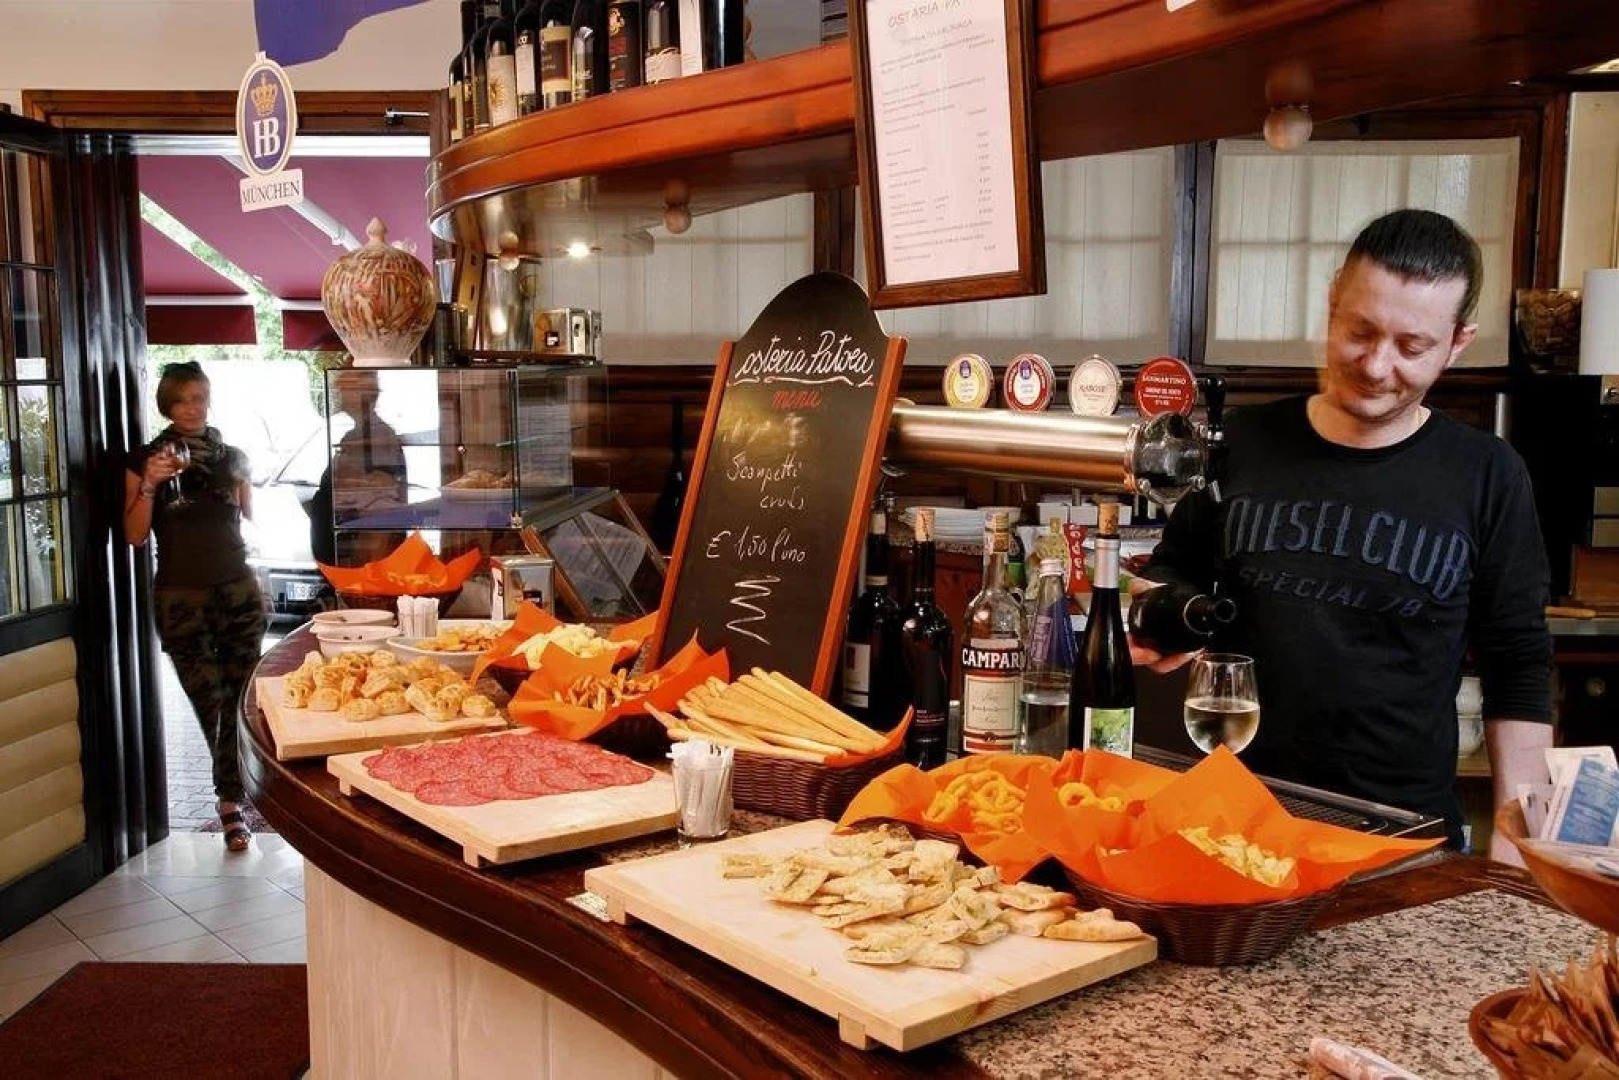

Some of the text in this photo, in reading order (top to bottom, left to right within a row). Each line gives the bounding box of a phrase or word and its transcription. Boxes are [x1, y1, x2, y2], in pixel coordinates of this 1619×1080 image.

[253, 117, 280, 158] HB
[241, 179, 299, 204] MÜNCHEN
[1361, 510, 1472, 601] CLUB
